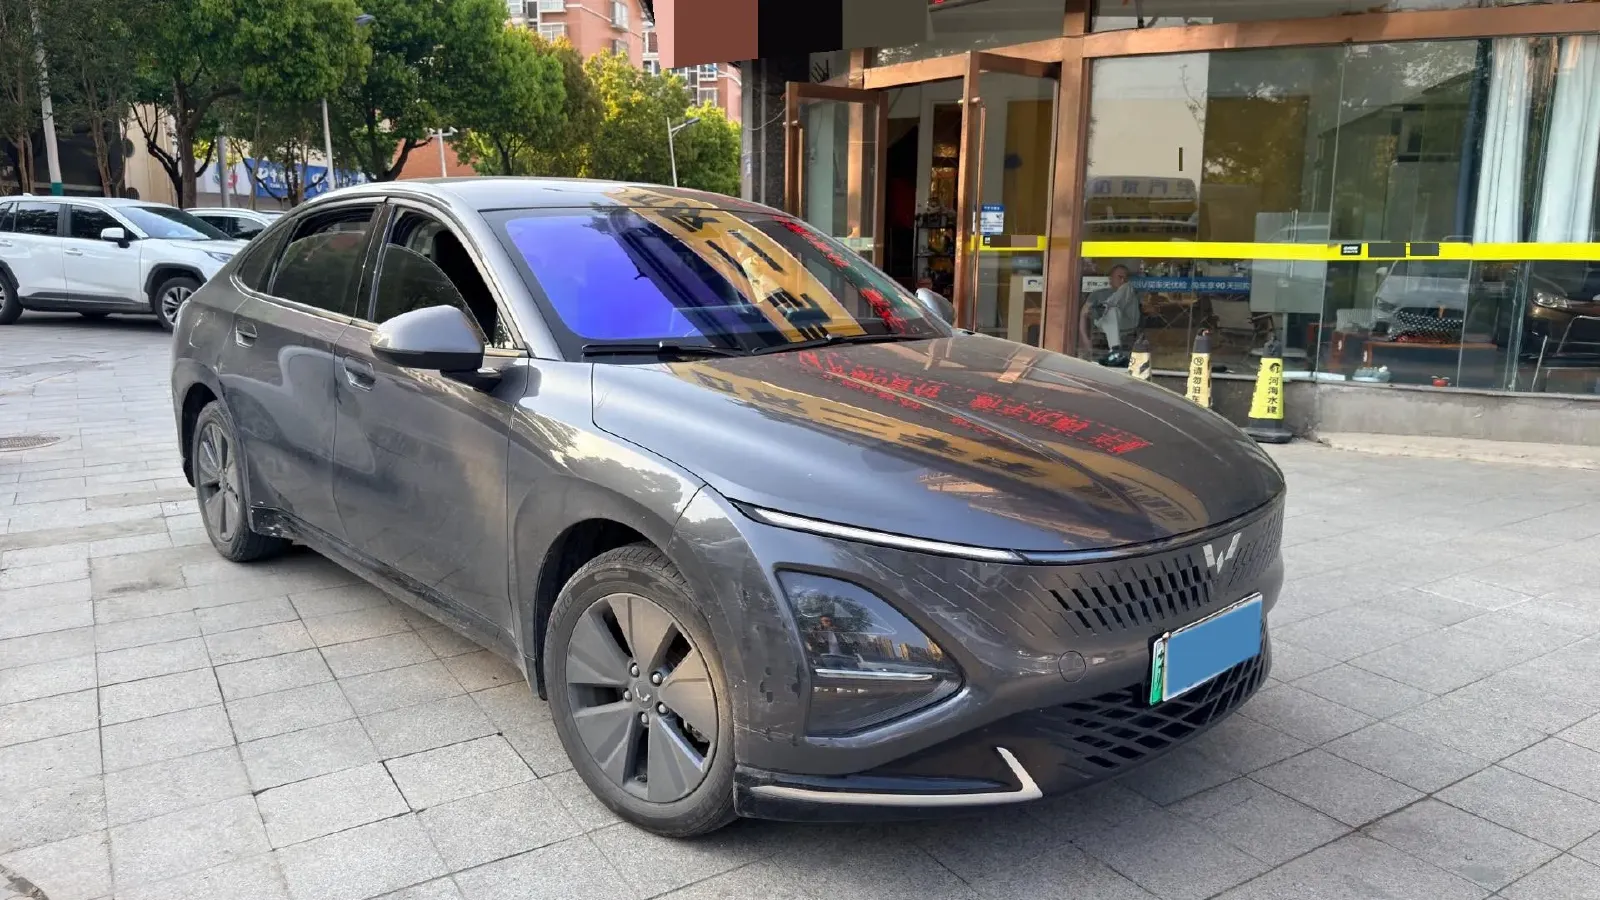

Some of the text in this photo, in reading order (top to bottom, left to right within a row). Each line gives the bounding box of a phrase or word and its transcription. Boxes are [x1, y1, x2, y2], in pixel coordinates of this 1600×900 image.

[1191, 367, 1203, 403] 请勿泊车
[1267, 376, 1280, 414] 河海水建
